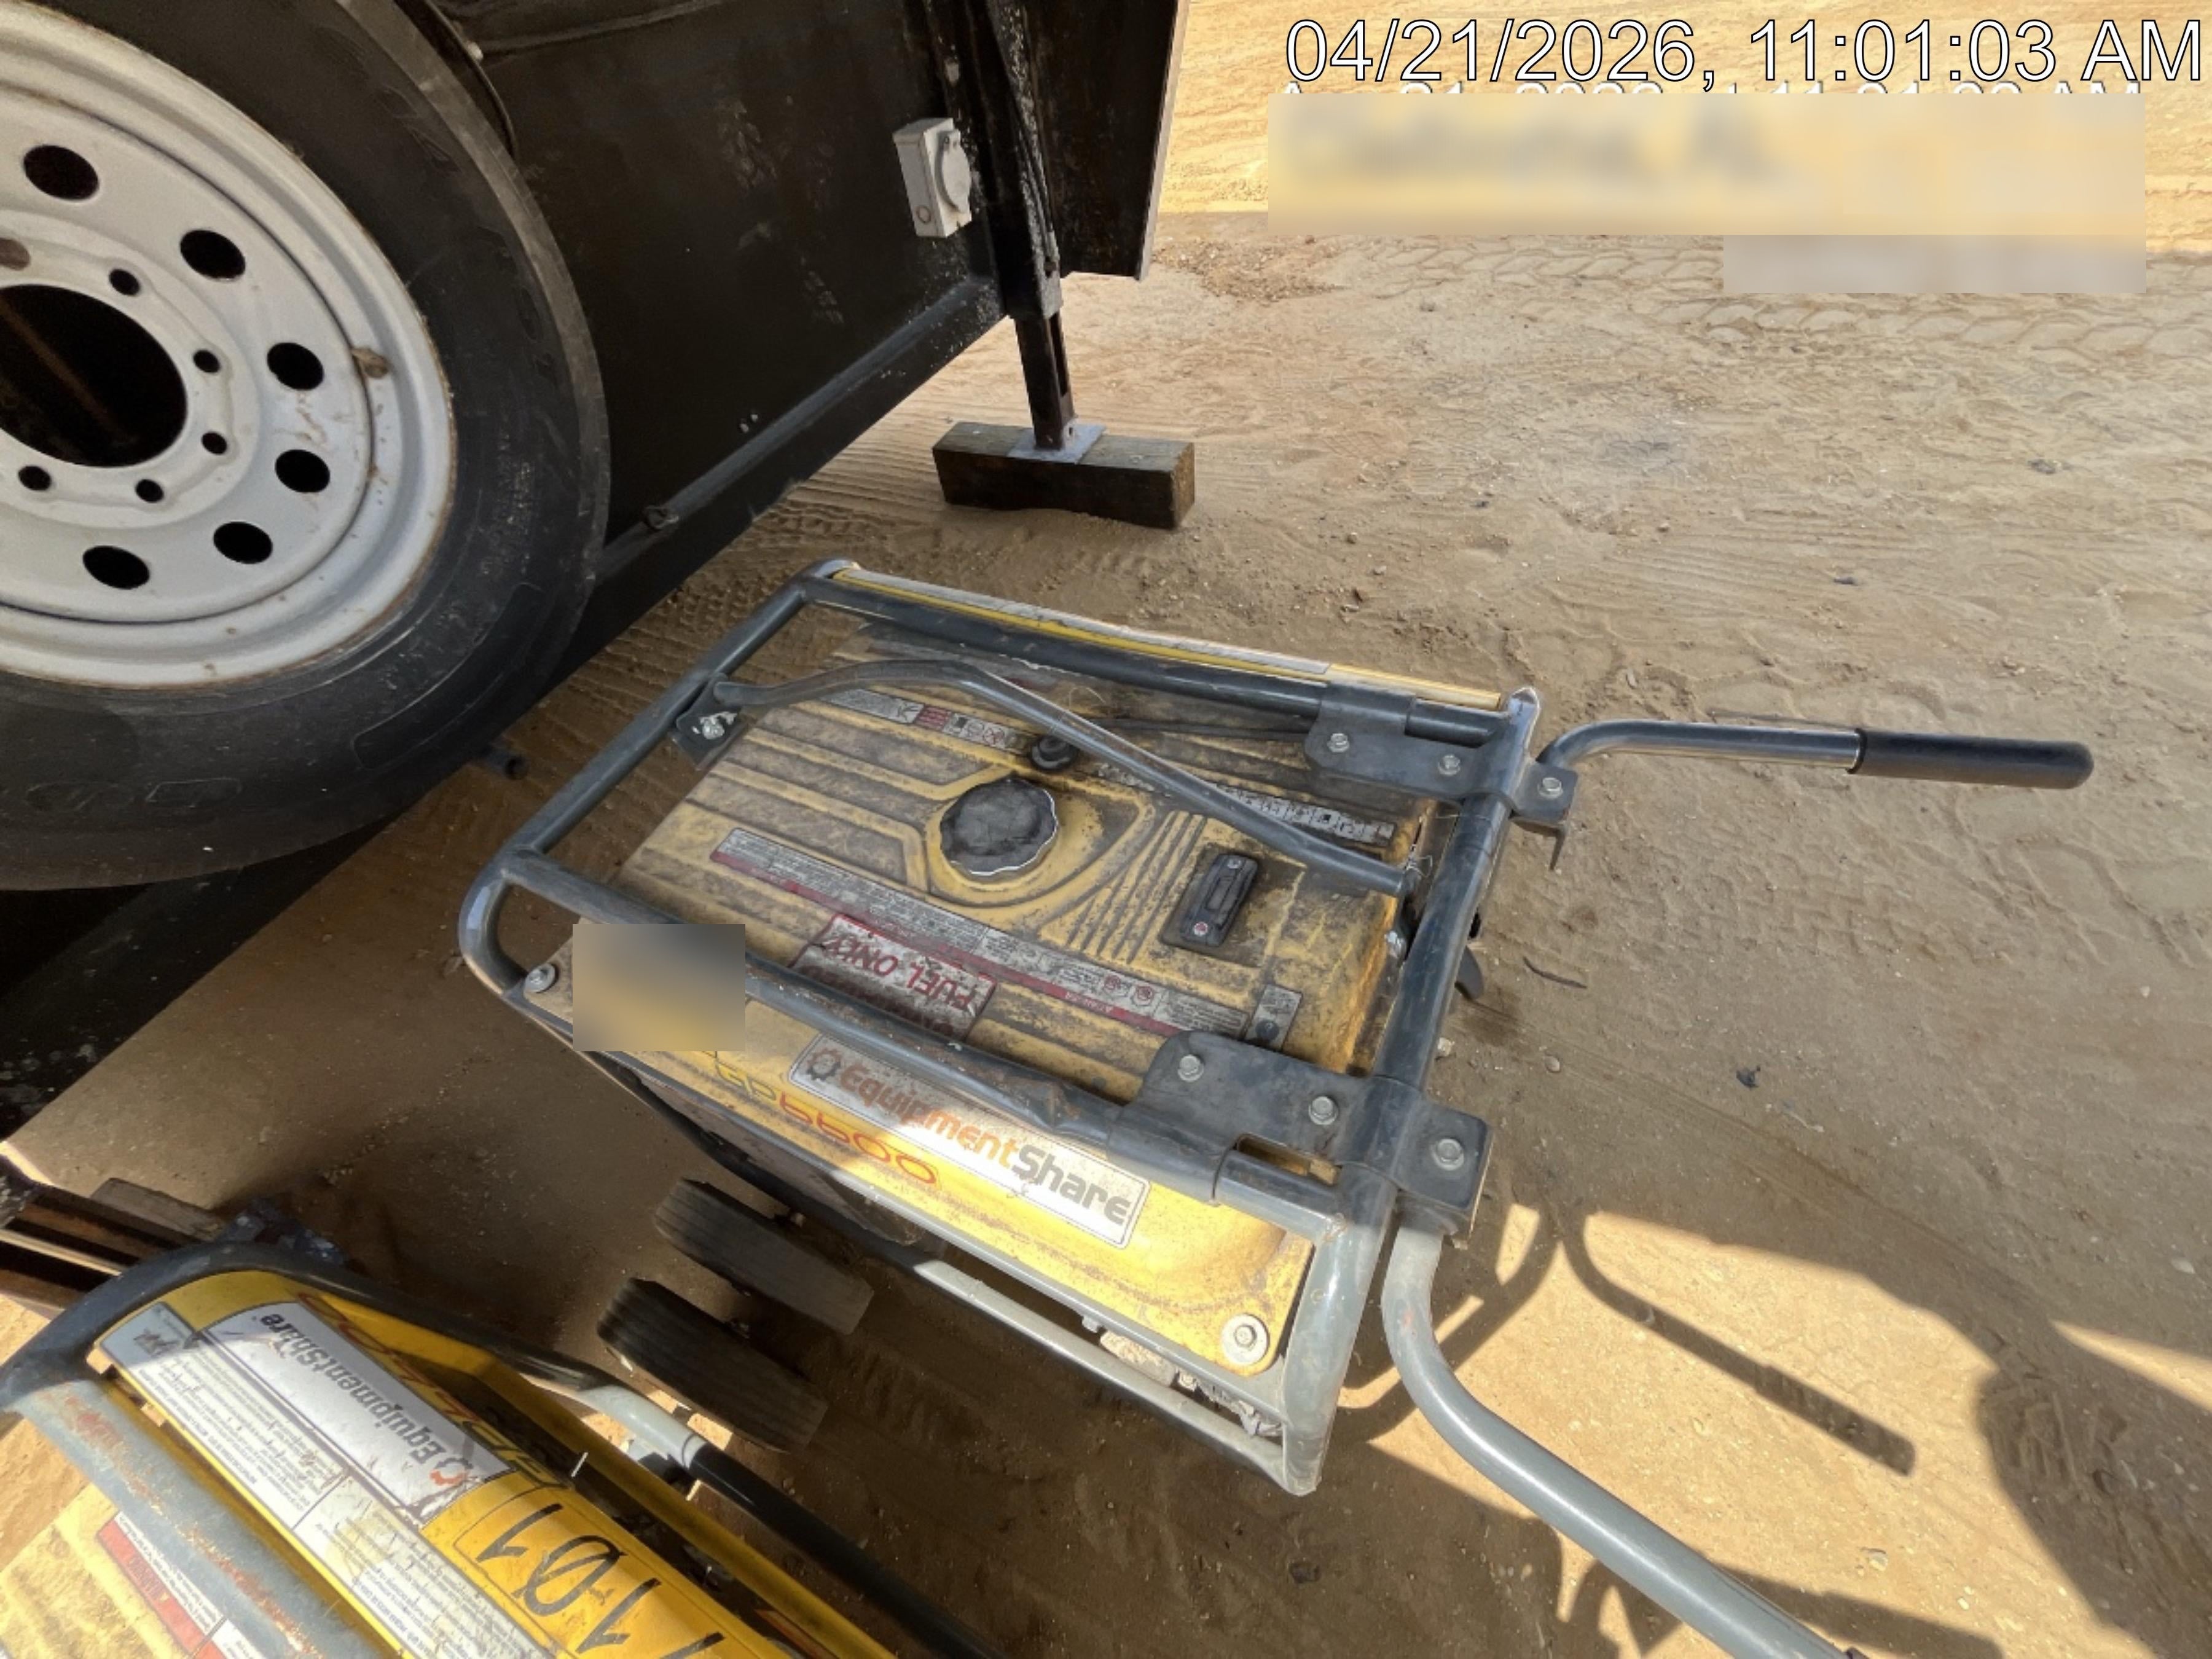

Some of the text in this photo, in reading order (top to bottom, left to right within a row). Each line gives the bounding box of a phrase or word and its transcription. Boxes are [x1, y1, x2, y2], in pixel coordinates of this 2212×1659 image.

[822, 932, 898, 976] ONLY
[906, 961, 979, 1010] FUEL
[839, 1062, 1132, 1227] EquipmentShare
[261, 1313, 446, 1465] EquipmentShare
